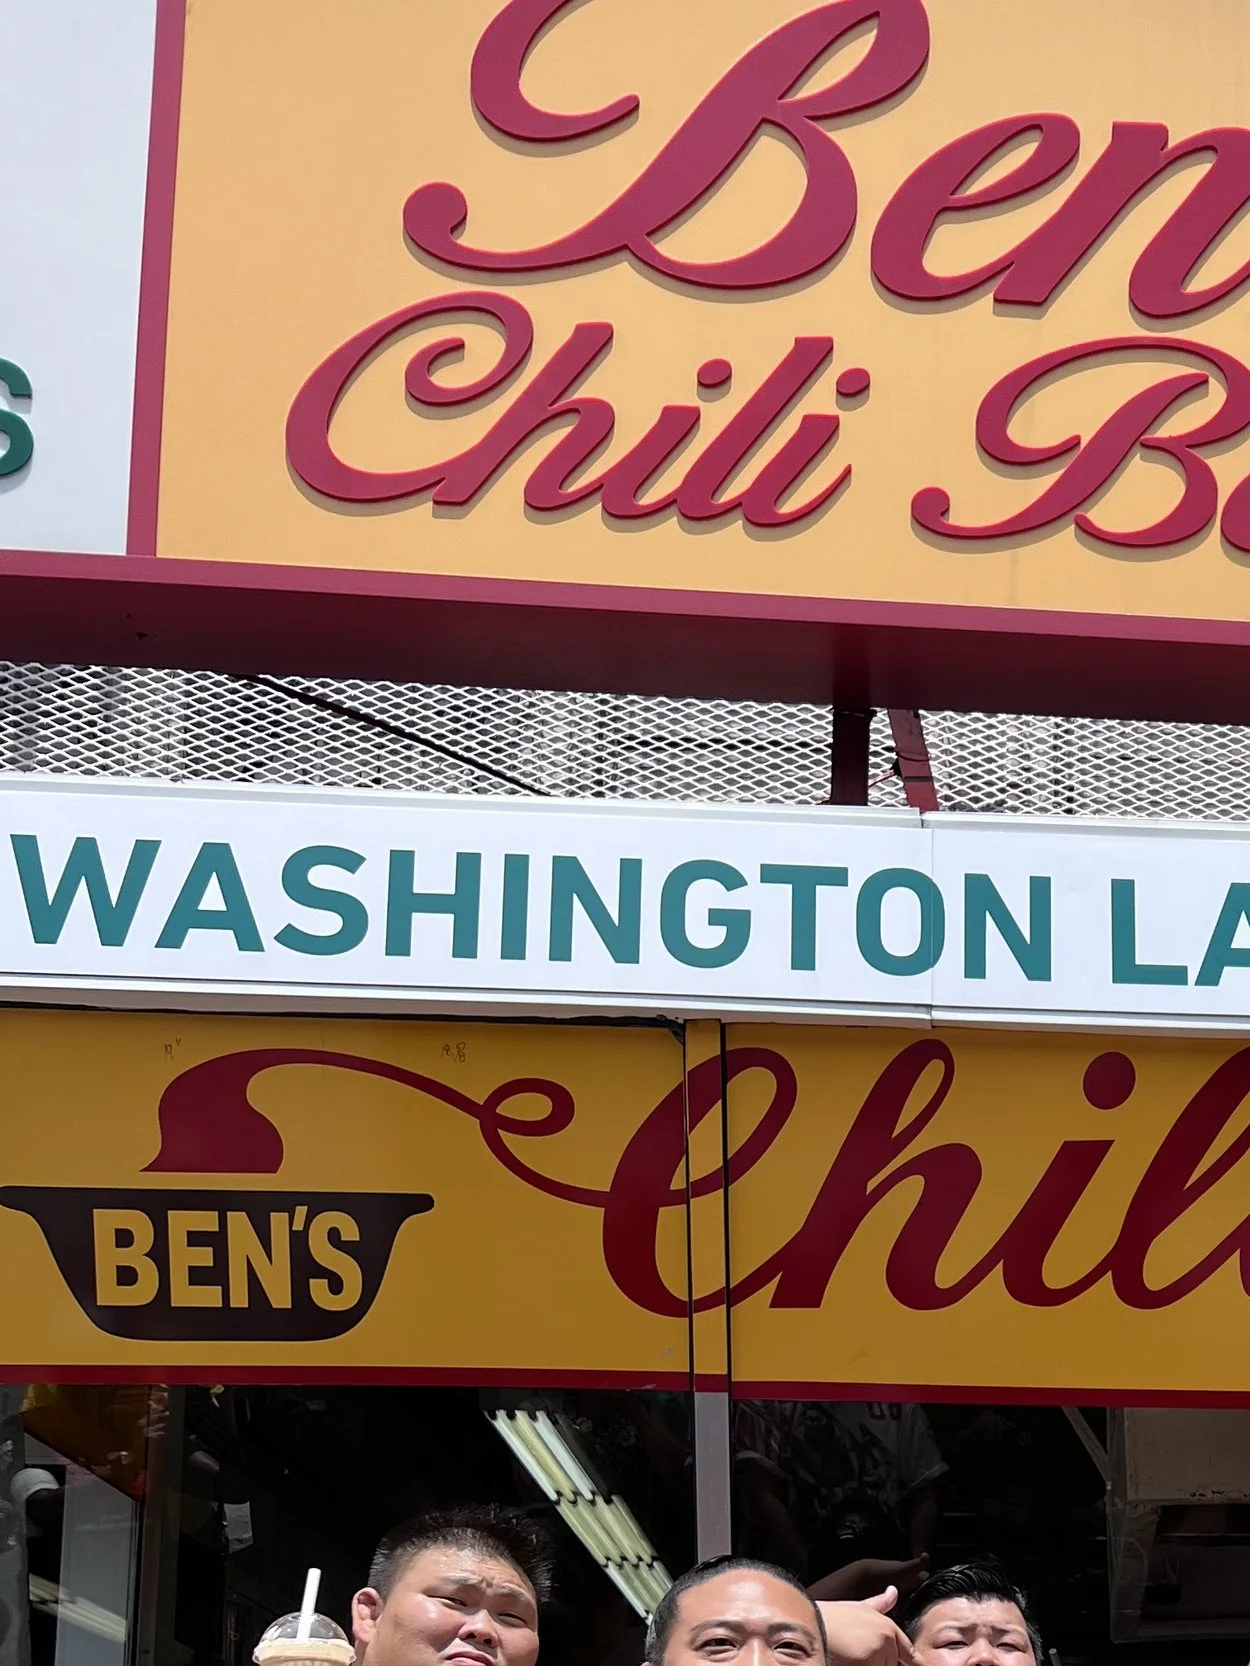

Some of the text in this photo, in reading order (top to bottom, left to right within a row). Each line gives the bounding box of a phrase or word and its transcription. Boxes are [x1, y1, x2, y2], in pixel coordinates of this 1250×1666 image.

[285, 291, 871, 526] Chili
[10, 834, 1052, 982] WASHINGTON
[93, 1207, 364, 1312] BEN'S
